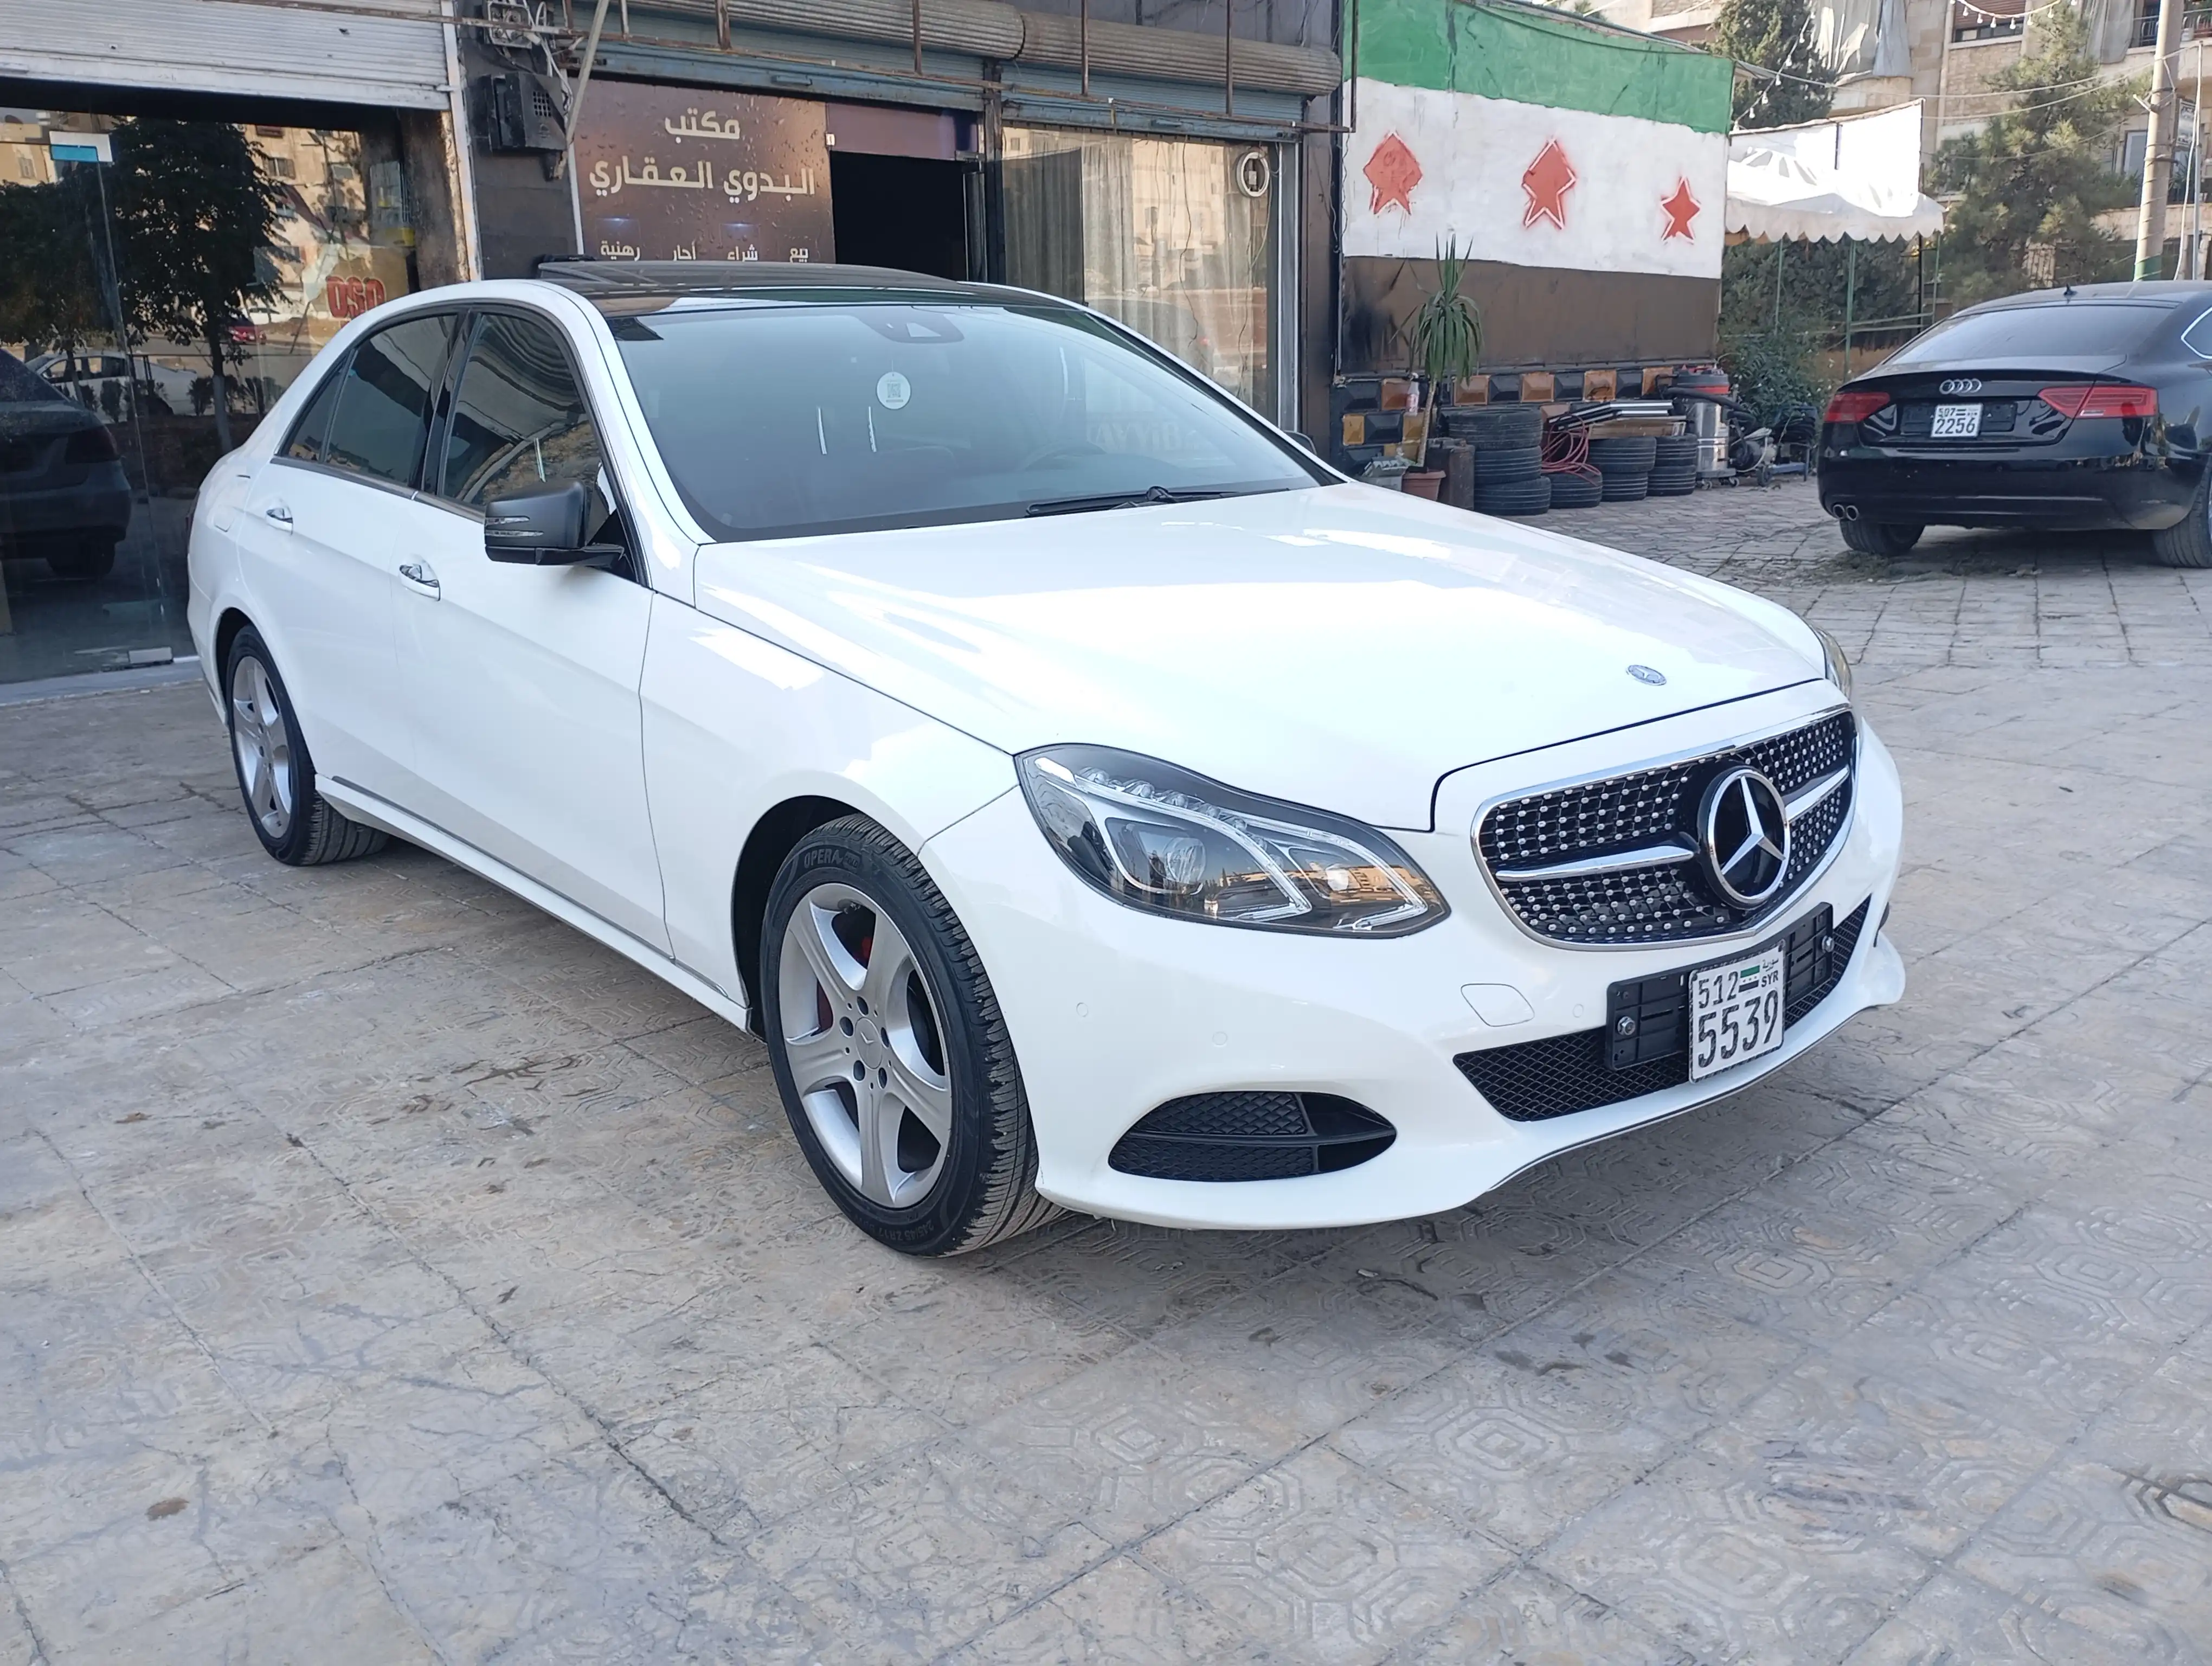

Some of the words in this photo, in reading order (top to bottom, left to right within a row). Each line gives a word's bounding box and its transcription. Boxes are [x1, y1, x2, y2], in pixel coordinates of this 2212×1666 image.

[664, 107, 741, 144] مكتب
[589, 156, 713, 197] العقاري
[723, 168, 815, 204] البدوي
[1934, 417, 1976, 434] 2256
[803, 848, 842, 868] OPERA
[1698, 971, 1739, 1009] 512
[1761, 970, 1778, 988] SYR
[1697, 989, 1779, 1068] 5539
